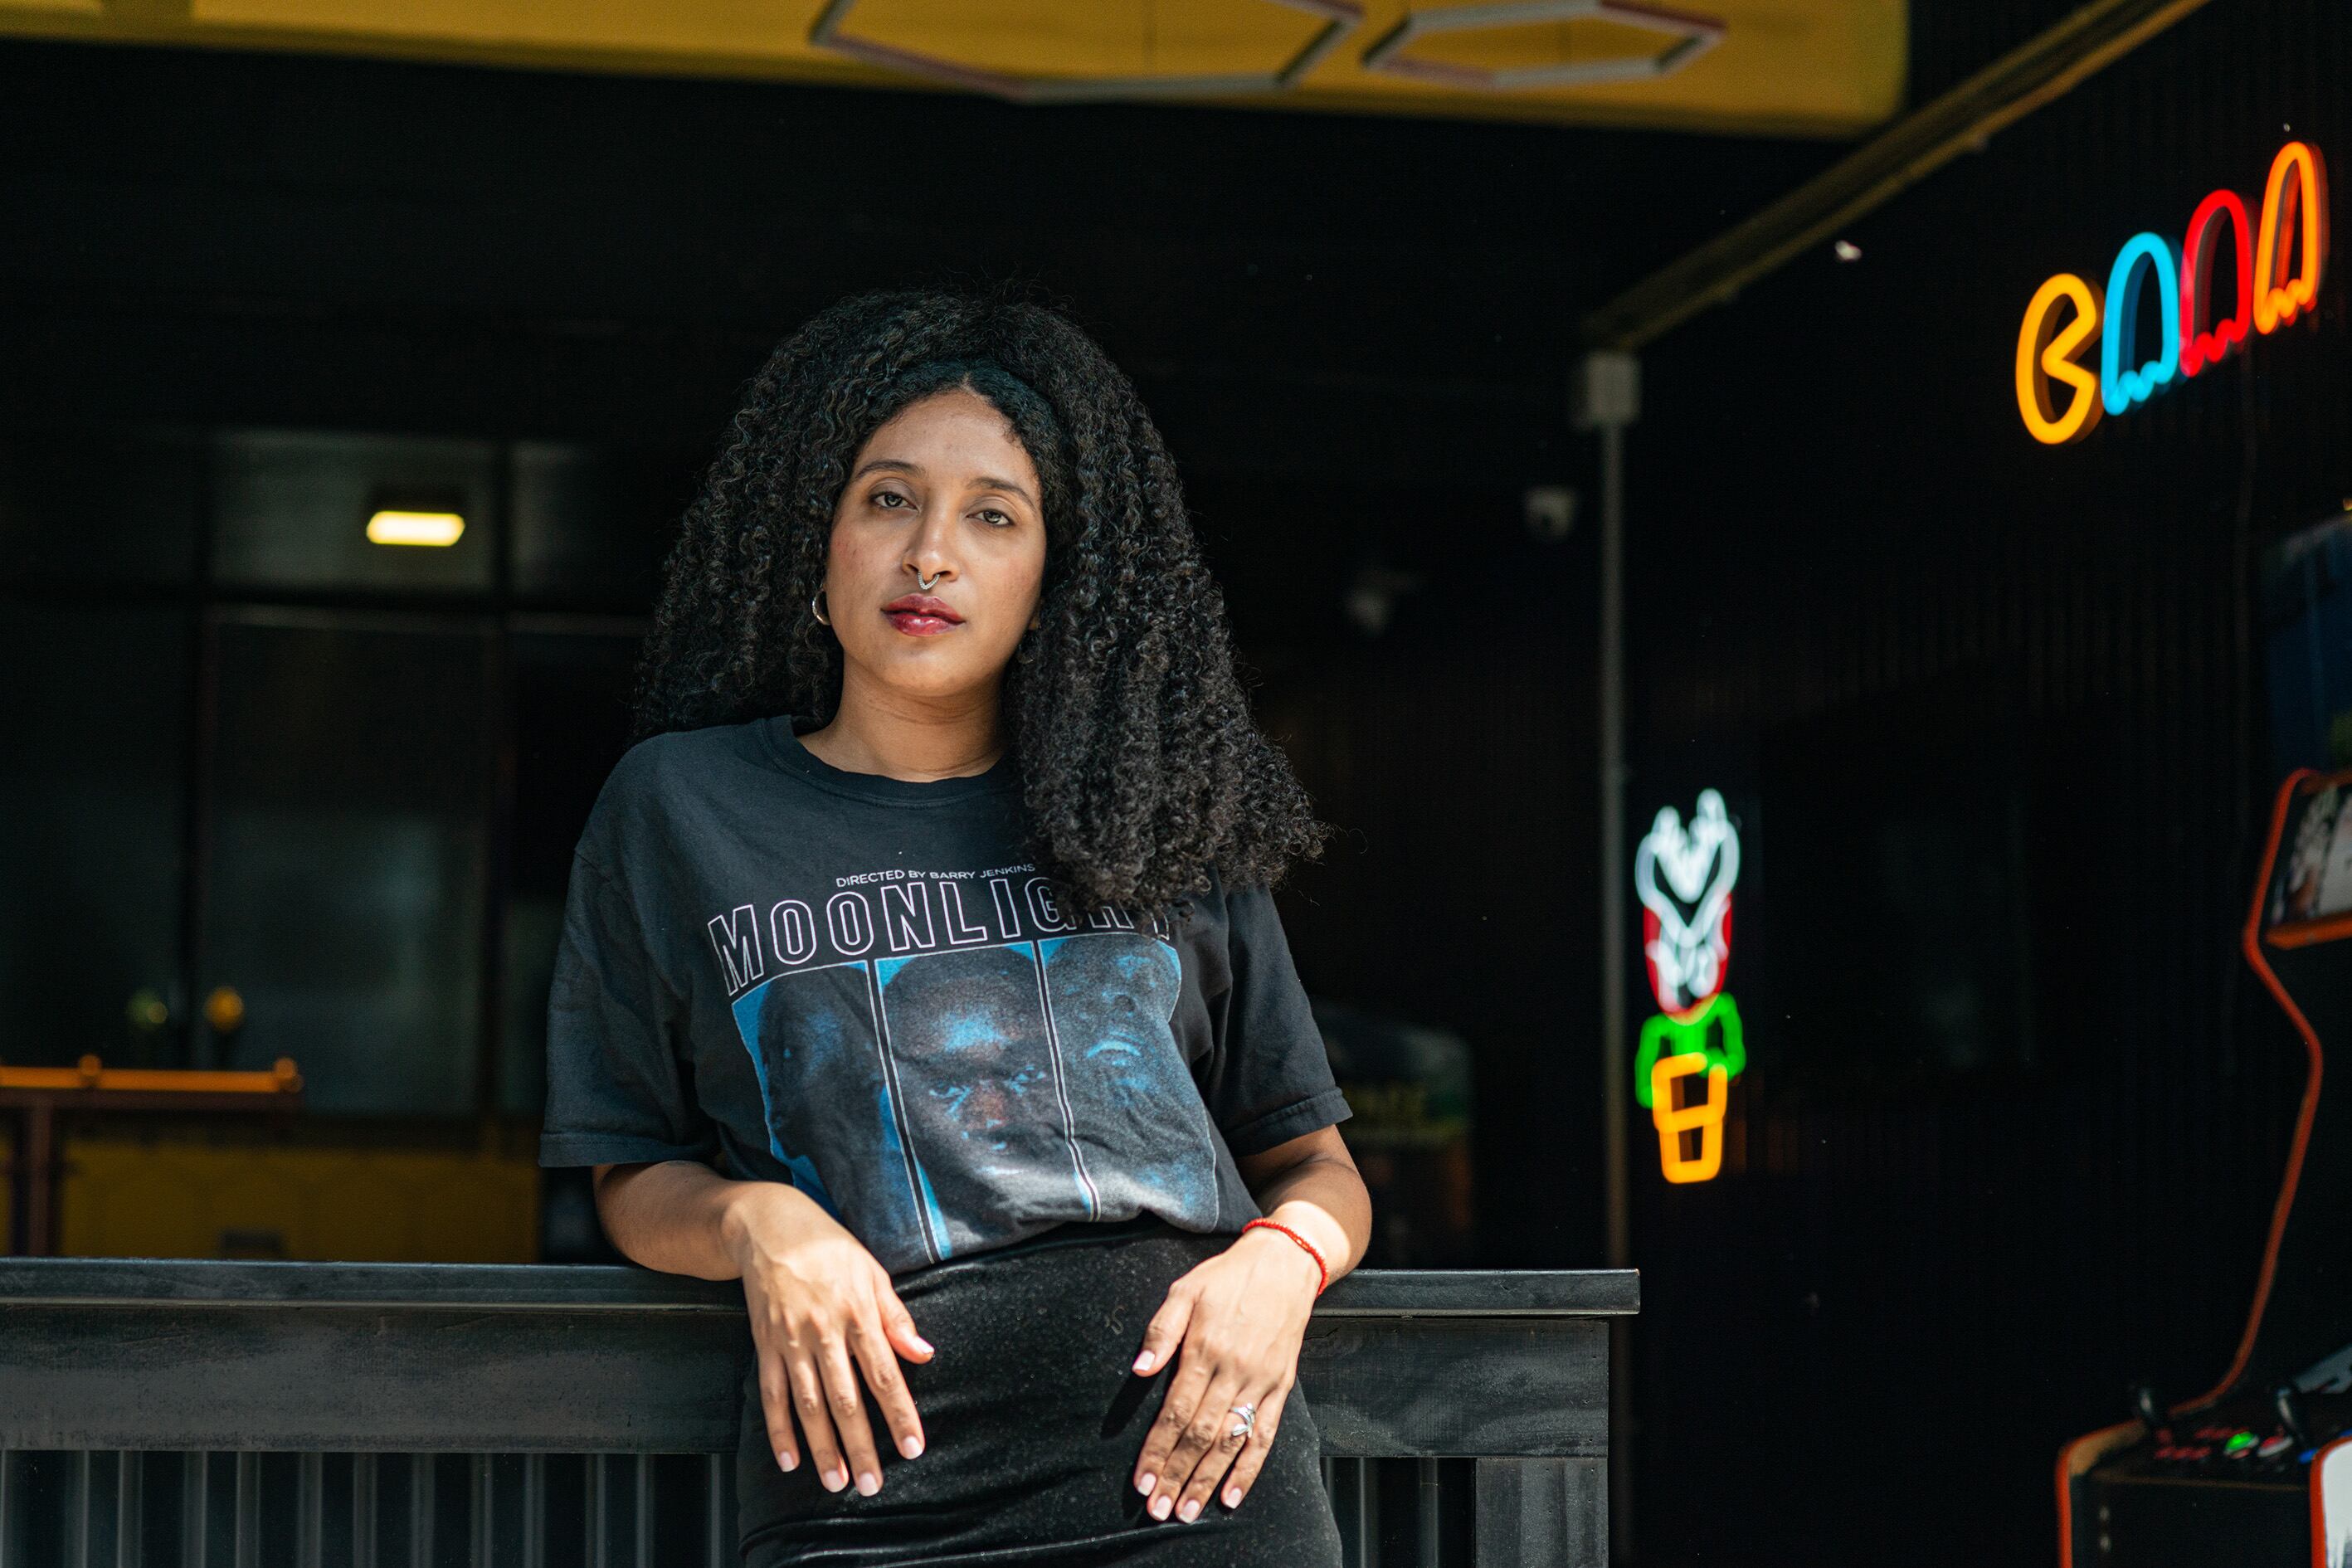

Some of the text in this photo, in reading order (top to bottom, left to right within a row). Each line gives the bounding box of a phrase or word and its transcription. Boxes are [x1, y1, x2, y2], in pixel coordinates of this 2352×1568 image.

[835, 863, 1036, 888] DIRECTED BY BARRY JENKINS
